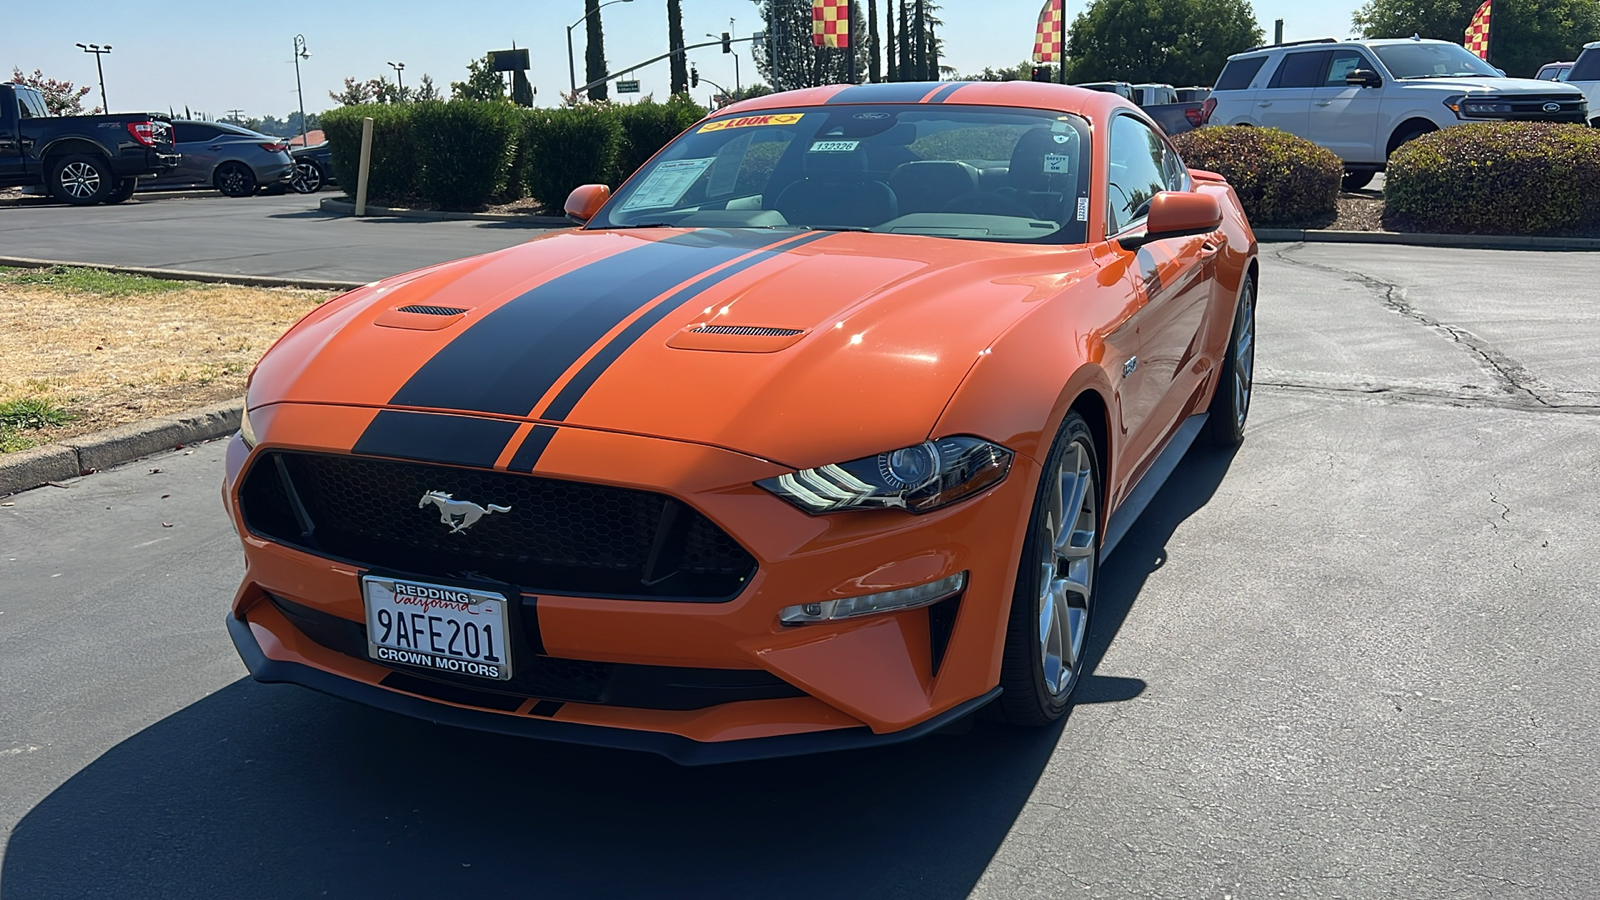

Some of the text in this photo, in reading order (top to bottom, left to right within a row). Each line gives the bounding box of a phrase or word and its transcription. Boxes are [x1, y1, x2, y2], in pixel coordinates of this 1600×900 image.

[724, 115, 773, 129] LOOK
[816, 142, 853, 151] 132326
[395, 583, 469, 604] REDDING
[377, 608, 500, 662] 9AFE201
[378, 647, 499, 678] CROWN MOTORS
